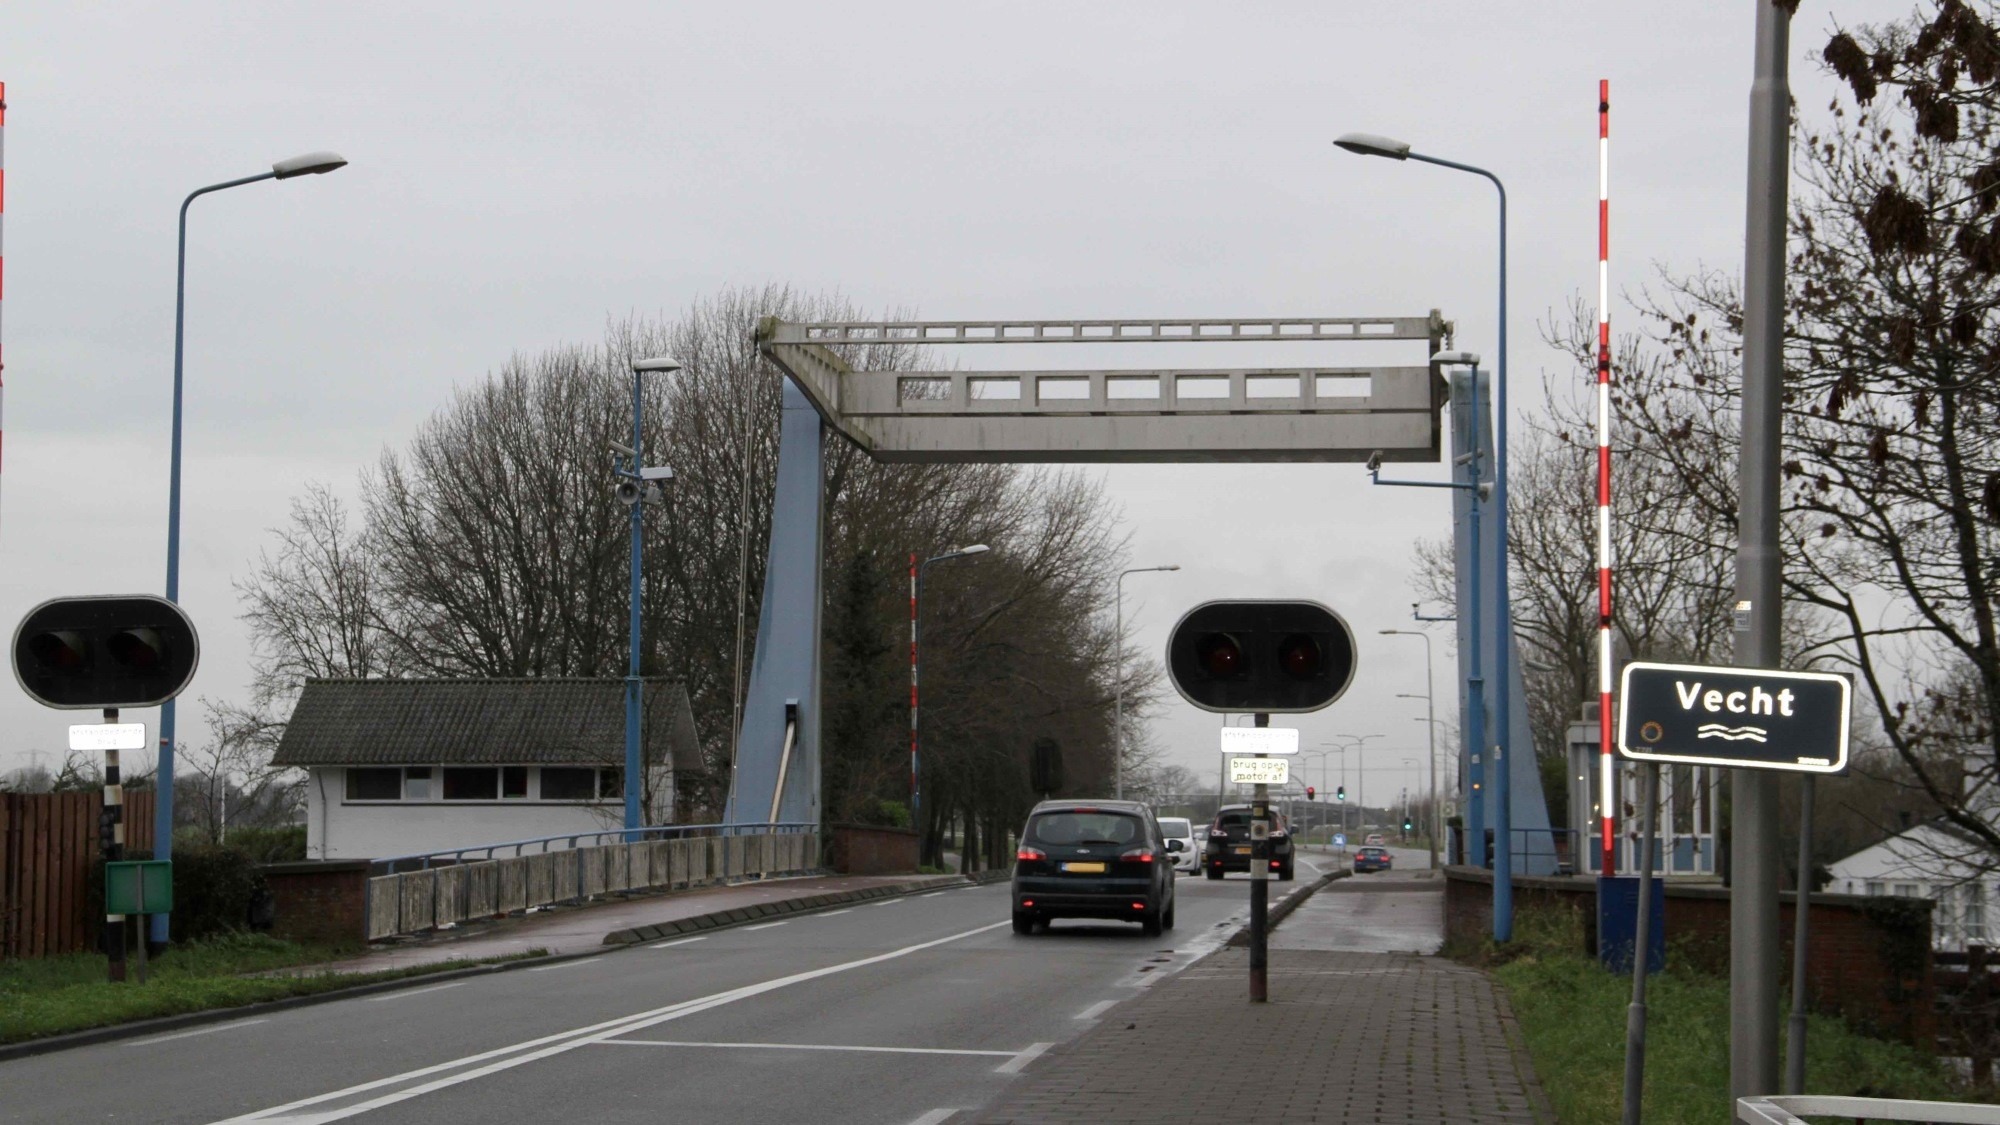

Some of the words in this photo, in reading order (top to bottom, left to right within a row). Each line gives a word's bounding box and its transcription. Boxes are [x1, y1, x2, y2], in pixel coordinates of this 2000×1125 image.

[1675, 680, 1795, 717] Vecht
[1233, 760, 1257, 771] brug
[1261, 762, 1286, 771] open
